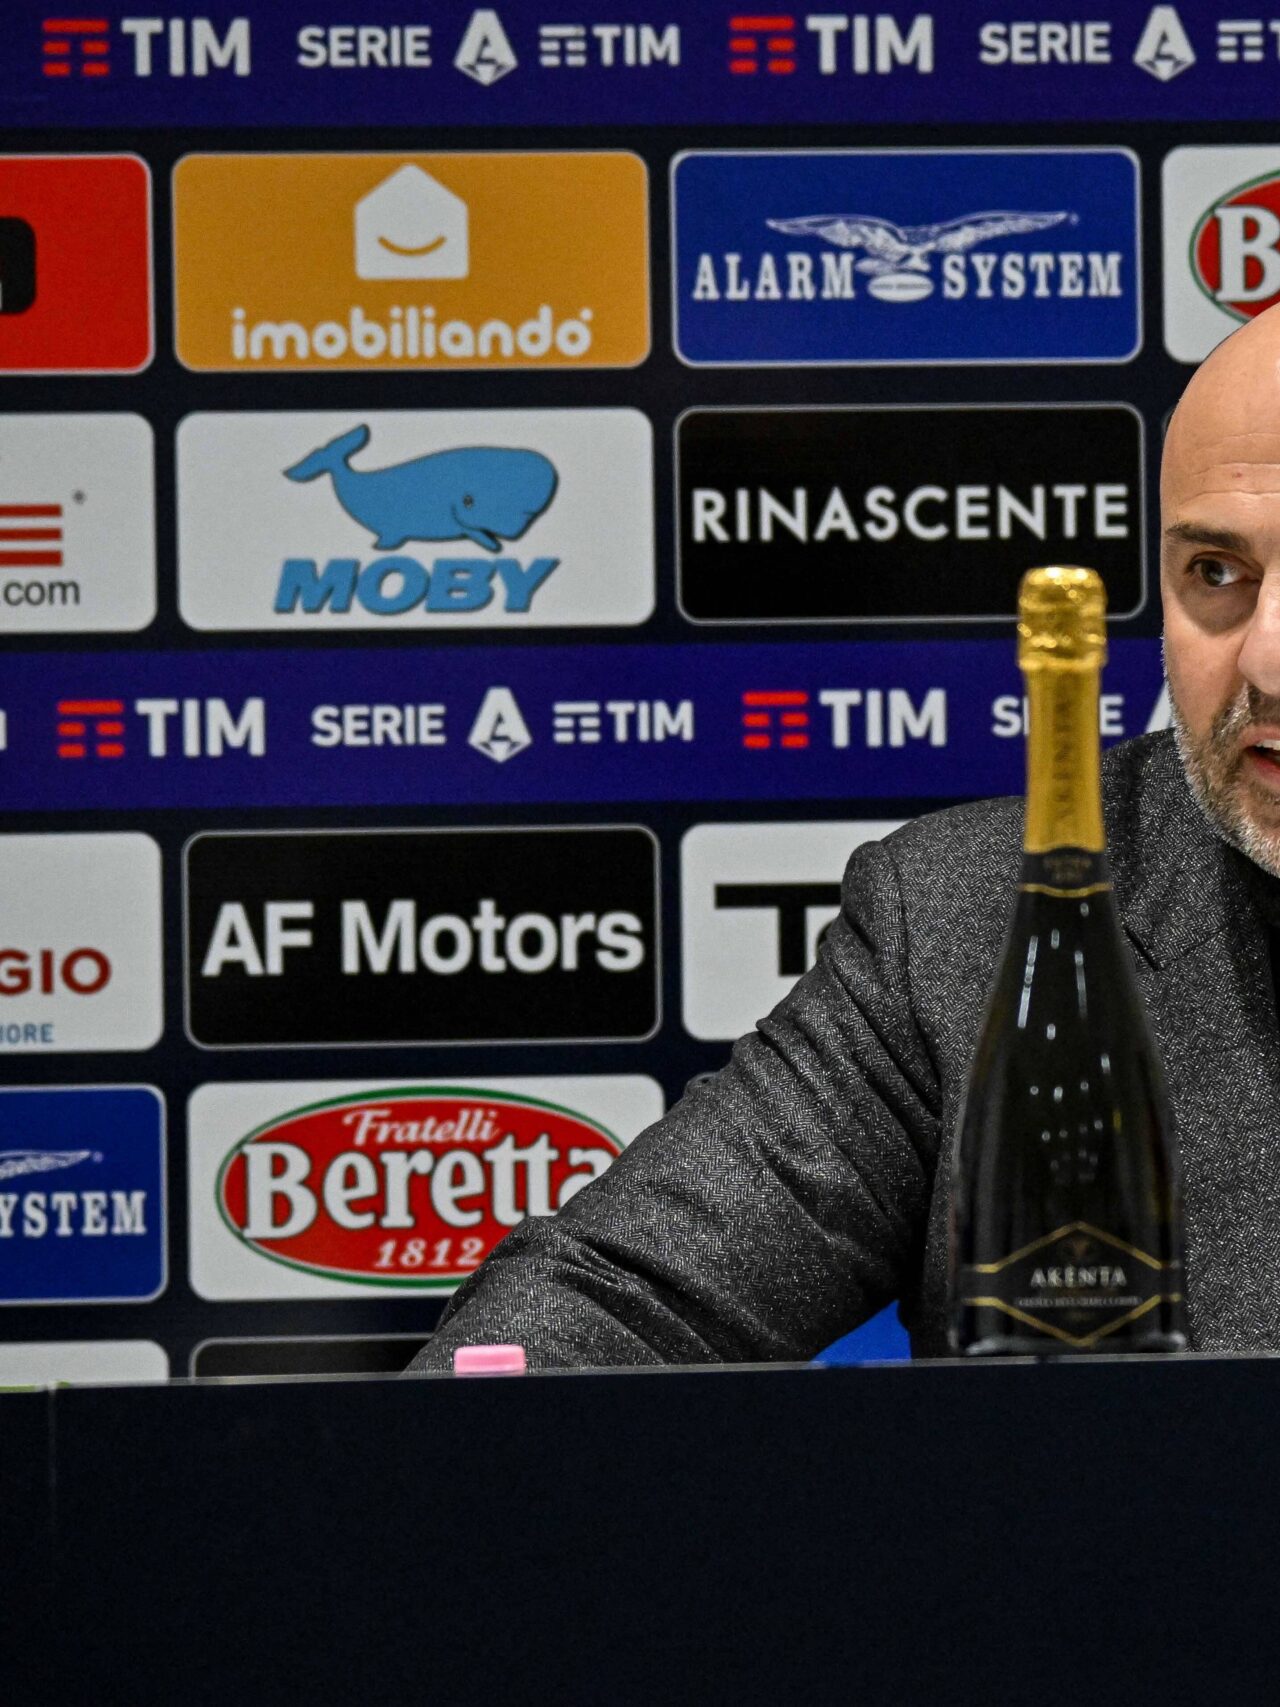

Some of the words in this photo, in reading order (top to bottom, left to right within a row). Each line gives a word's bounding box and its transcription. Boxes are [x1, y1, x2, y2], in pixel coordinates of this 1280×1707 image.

[122, 18, 250, 76] TIM
[297, 26, 432, 67] SERIE
[592, 24, 680, 66] TIM
[806, 15, 933, 74] TIM
[979, 22, 1111, 64] SERIE
[692, 252, 856, 301] ALARM
[941, 250, 1122, 299] SYSTEM
[232, 307, 592, 360] imobiliando
[692, 483, 1128, 542] RINASCENTE
[273, 557, 558, 614] MOBY
[135, 697, 265, 757] TIM
[311, 704, 446, 747] SERIE
[606, 700, 694, 742] TIM
[819, 688, 946, 748] TIM
[202, 901, 314, 976] AF
[342, 899, 644, 974] Motors
[0, 1023, 54, 1044] ORE
[342, 1109, 501, 1146] Fratelli
[373, 1236, 485, 1269] 1812
